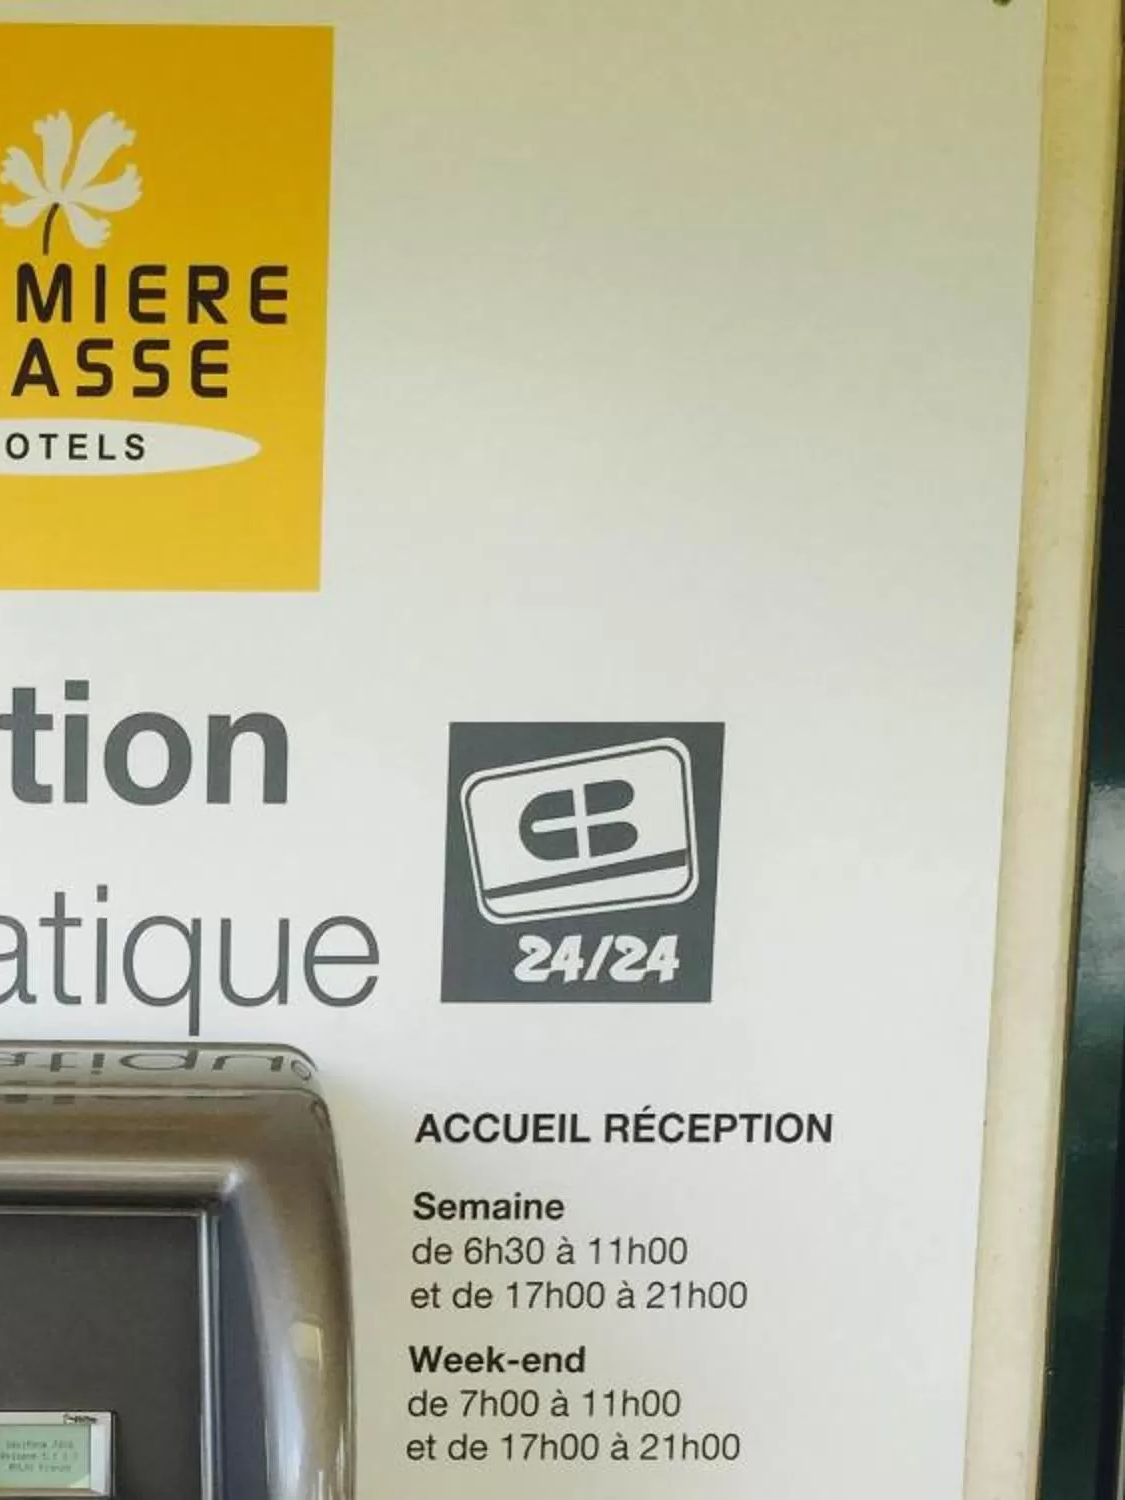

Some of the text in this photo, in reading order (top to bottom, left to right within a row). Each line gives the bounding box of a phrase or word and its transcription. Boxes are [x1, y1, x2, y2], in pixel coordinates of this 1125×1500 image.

[513, 934, 680, 983] 24/24
[414, 1104, 833, 1144] ACCUEIL RÉCEPTION
[412, 1191, 566, 1222] Semaine
[411, 1235, 688, 1265] de 6h30 à 11h00
[410, 1279, 748, 1310] et de 17h00 à 21h00
[408, 1345, 586, 1374] Week-end
[407, 1388, 682, 1418] de 7h00 à 11h00
[406, 1431, 741, 1462] et de 17h00 à 21h00
